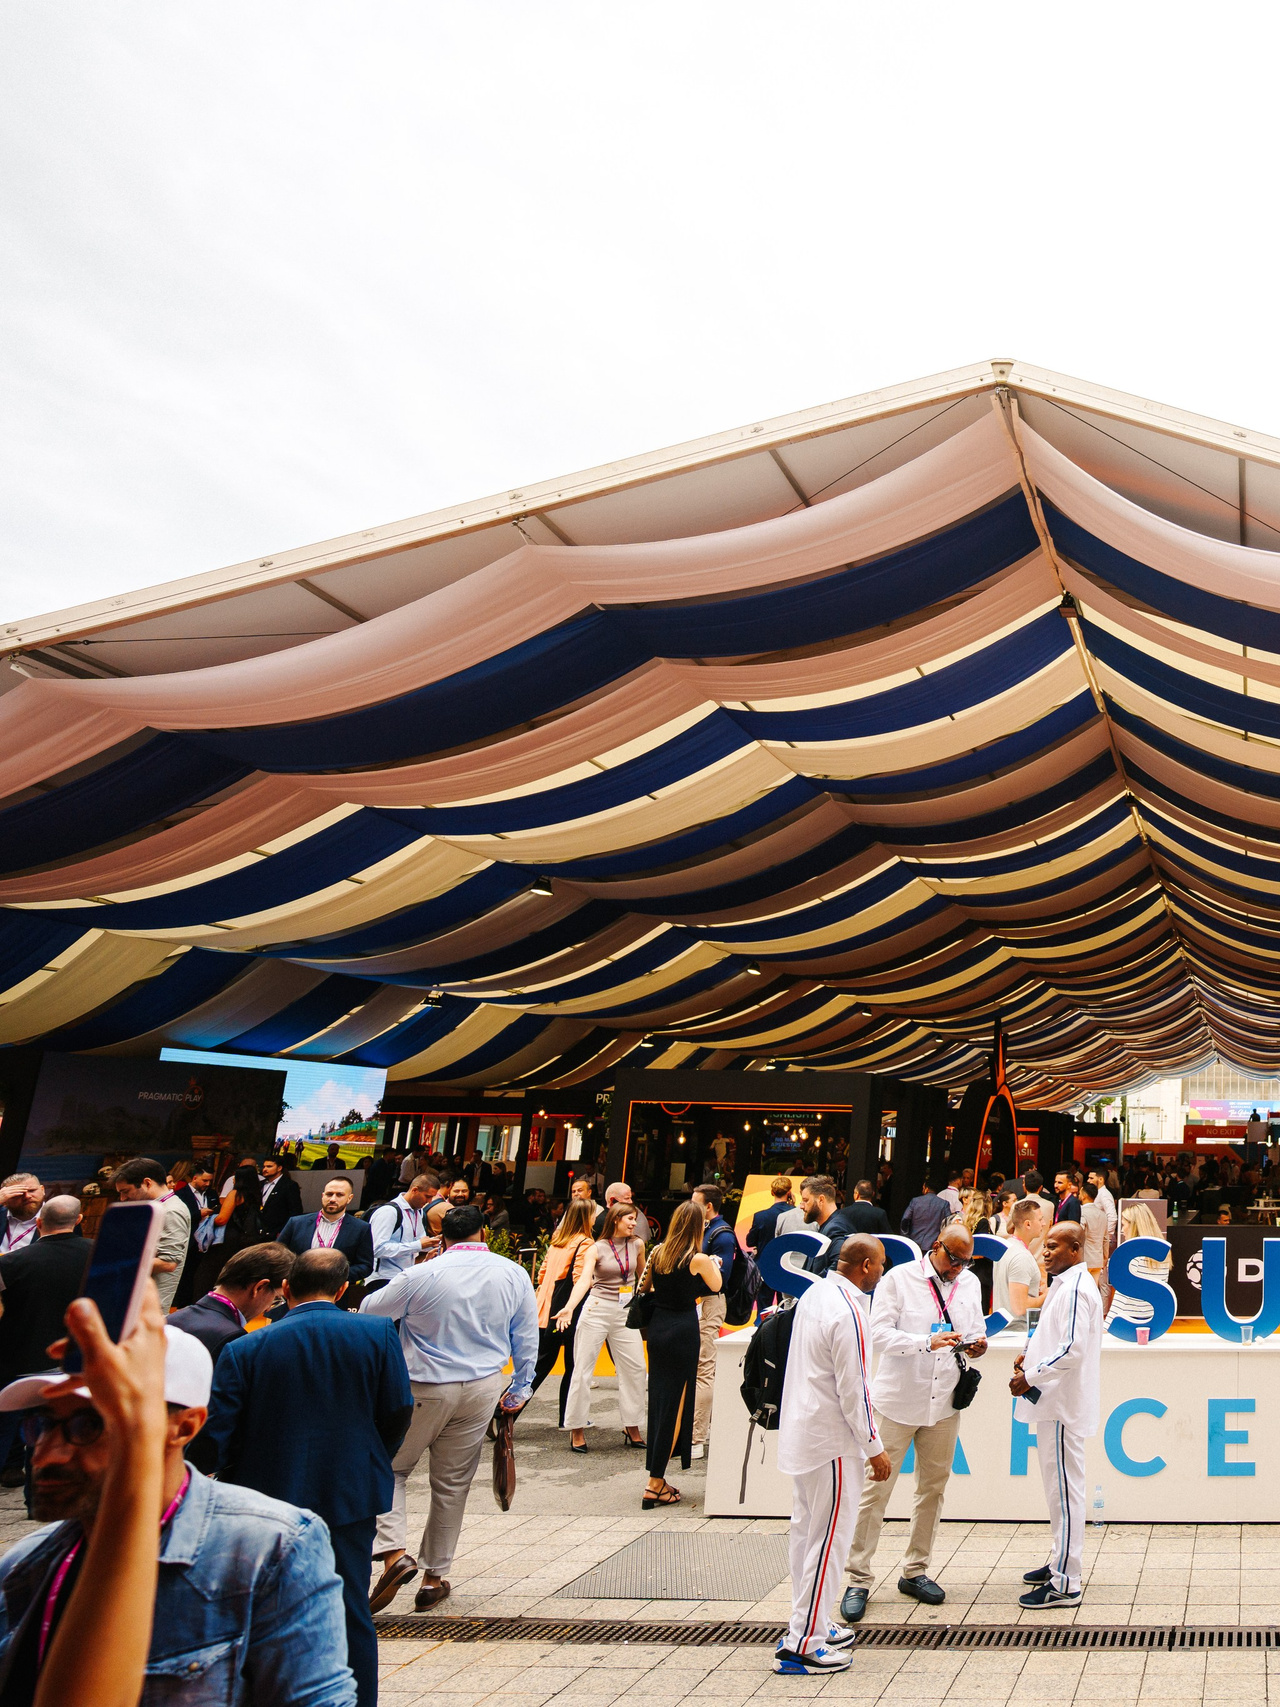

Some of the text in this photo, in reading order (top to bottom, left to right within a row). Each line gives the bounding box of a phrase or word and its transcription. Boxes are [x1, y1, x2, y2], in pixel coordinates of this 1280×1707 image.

[138, 1091, 203, 1102] PRAGMATIC PLAY
[1206, 1128, 1237, 1136] NO EXIT
